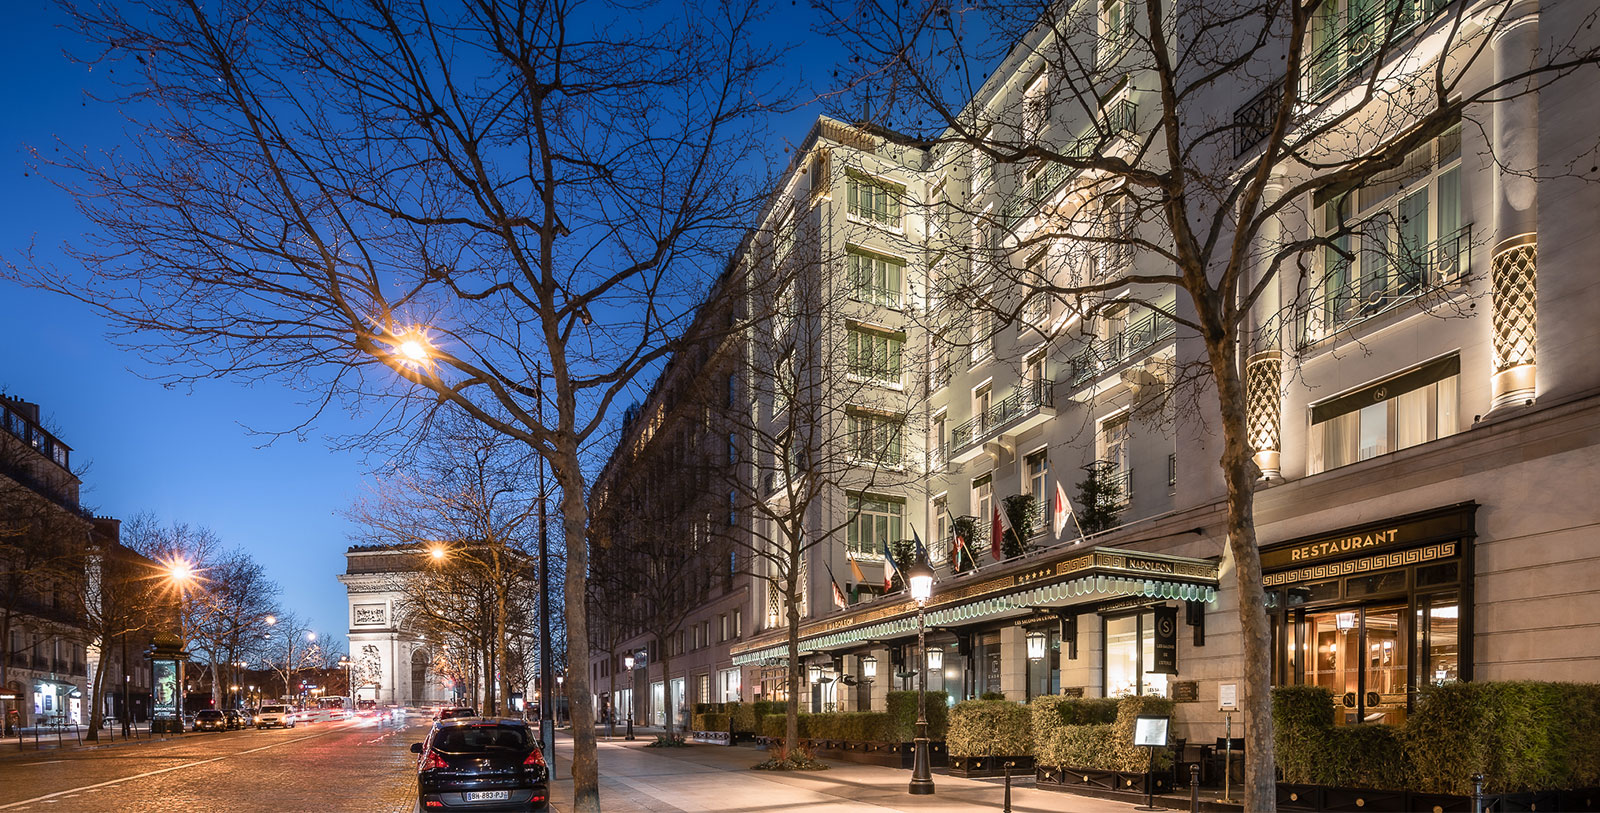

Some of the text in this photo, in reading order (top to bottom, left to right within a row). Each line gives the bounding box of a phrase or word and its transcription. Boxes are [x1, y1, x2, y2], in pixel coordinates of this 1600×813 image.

[1291, 528, 1398, 561] RESTAURANT
[1129, 559, 1172, 573] NAPOLEON
[1163, 620, 1169, 633] S
[1345, 695, 1354, 705] N
[1368, 694, 1378, 705] N
